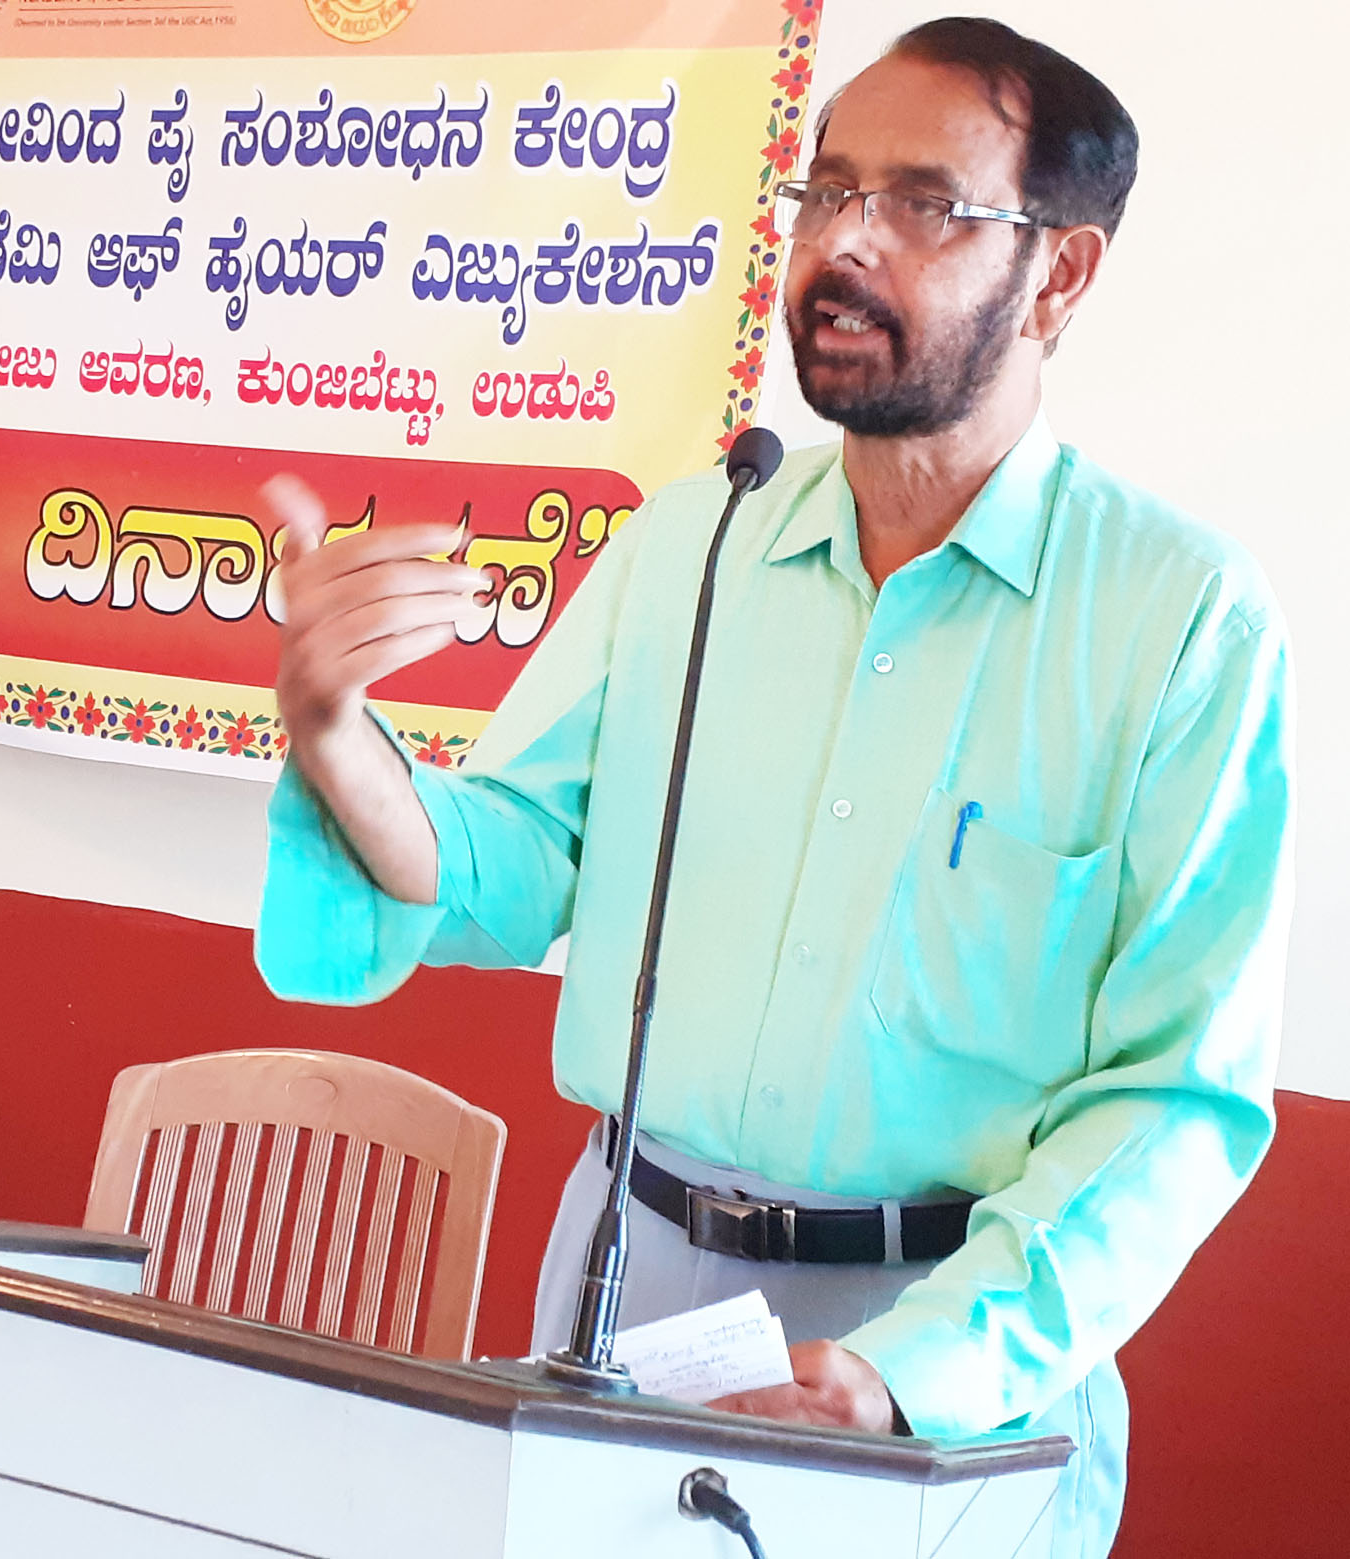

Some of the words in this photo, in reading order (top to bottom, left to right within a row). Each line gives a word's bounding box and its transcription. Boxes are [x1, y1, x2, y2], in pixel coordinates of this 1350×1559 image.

[147, 88, 195, 203] ಪೈ
[220, 87, 489, 181] ಸಂಶೋಧನ
[514, 84, 676, 199] ಕೇಂದ್ರ
[87, 216, 183, 303] ಆಫ್
[205, 216, 388, 332] ಹೈಯರ್
[412, 222, 718, 346] ಎಜ್ಯುಕೇಶನ್
[79, 338, 212, 406] ಆವರಣ,
[236, 344, 445, 447] ಕುಂಜಿಬೆಟ್ಟು,
[472, 357, 616, 422] ಉಡುಪಿ
[24, 487, 634, 649] ದಿನಾಣೆ”
